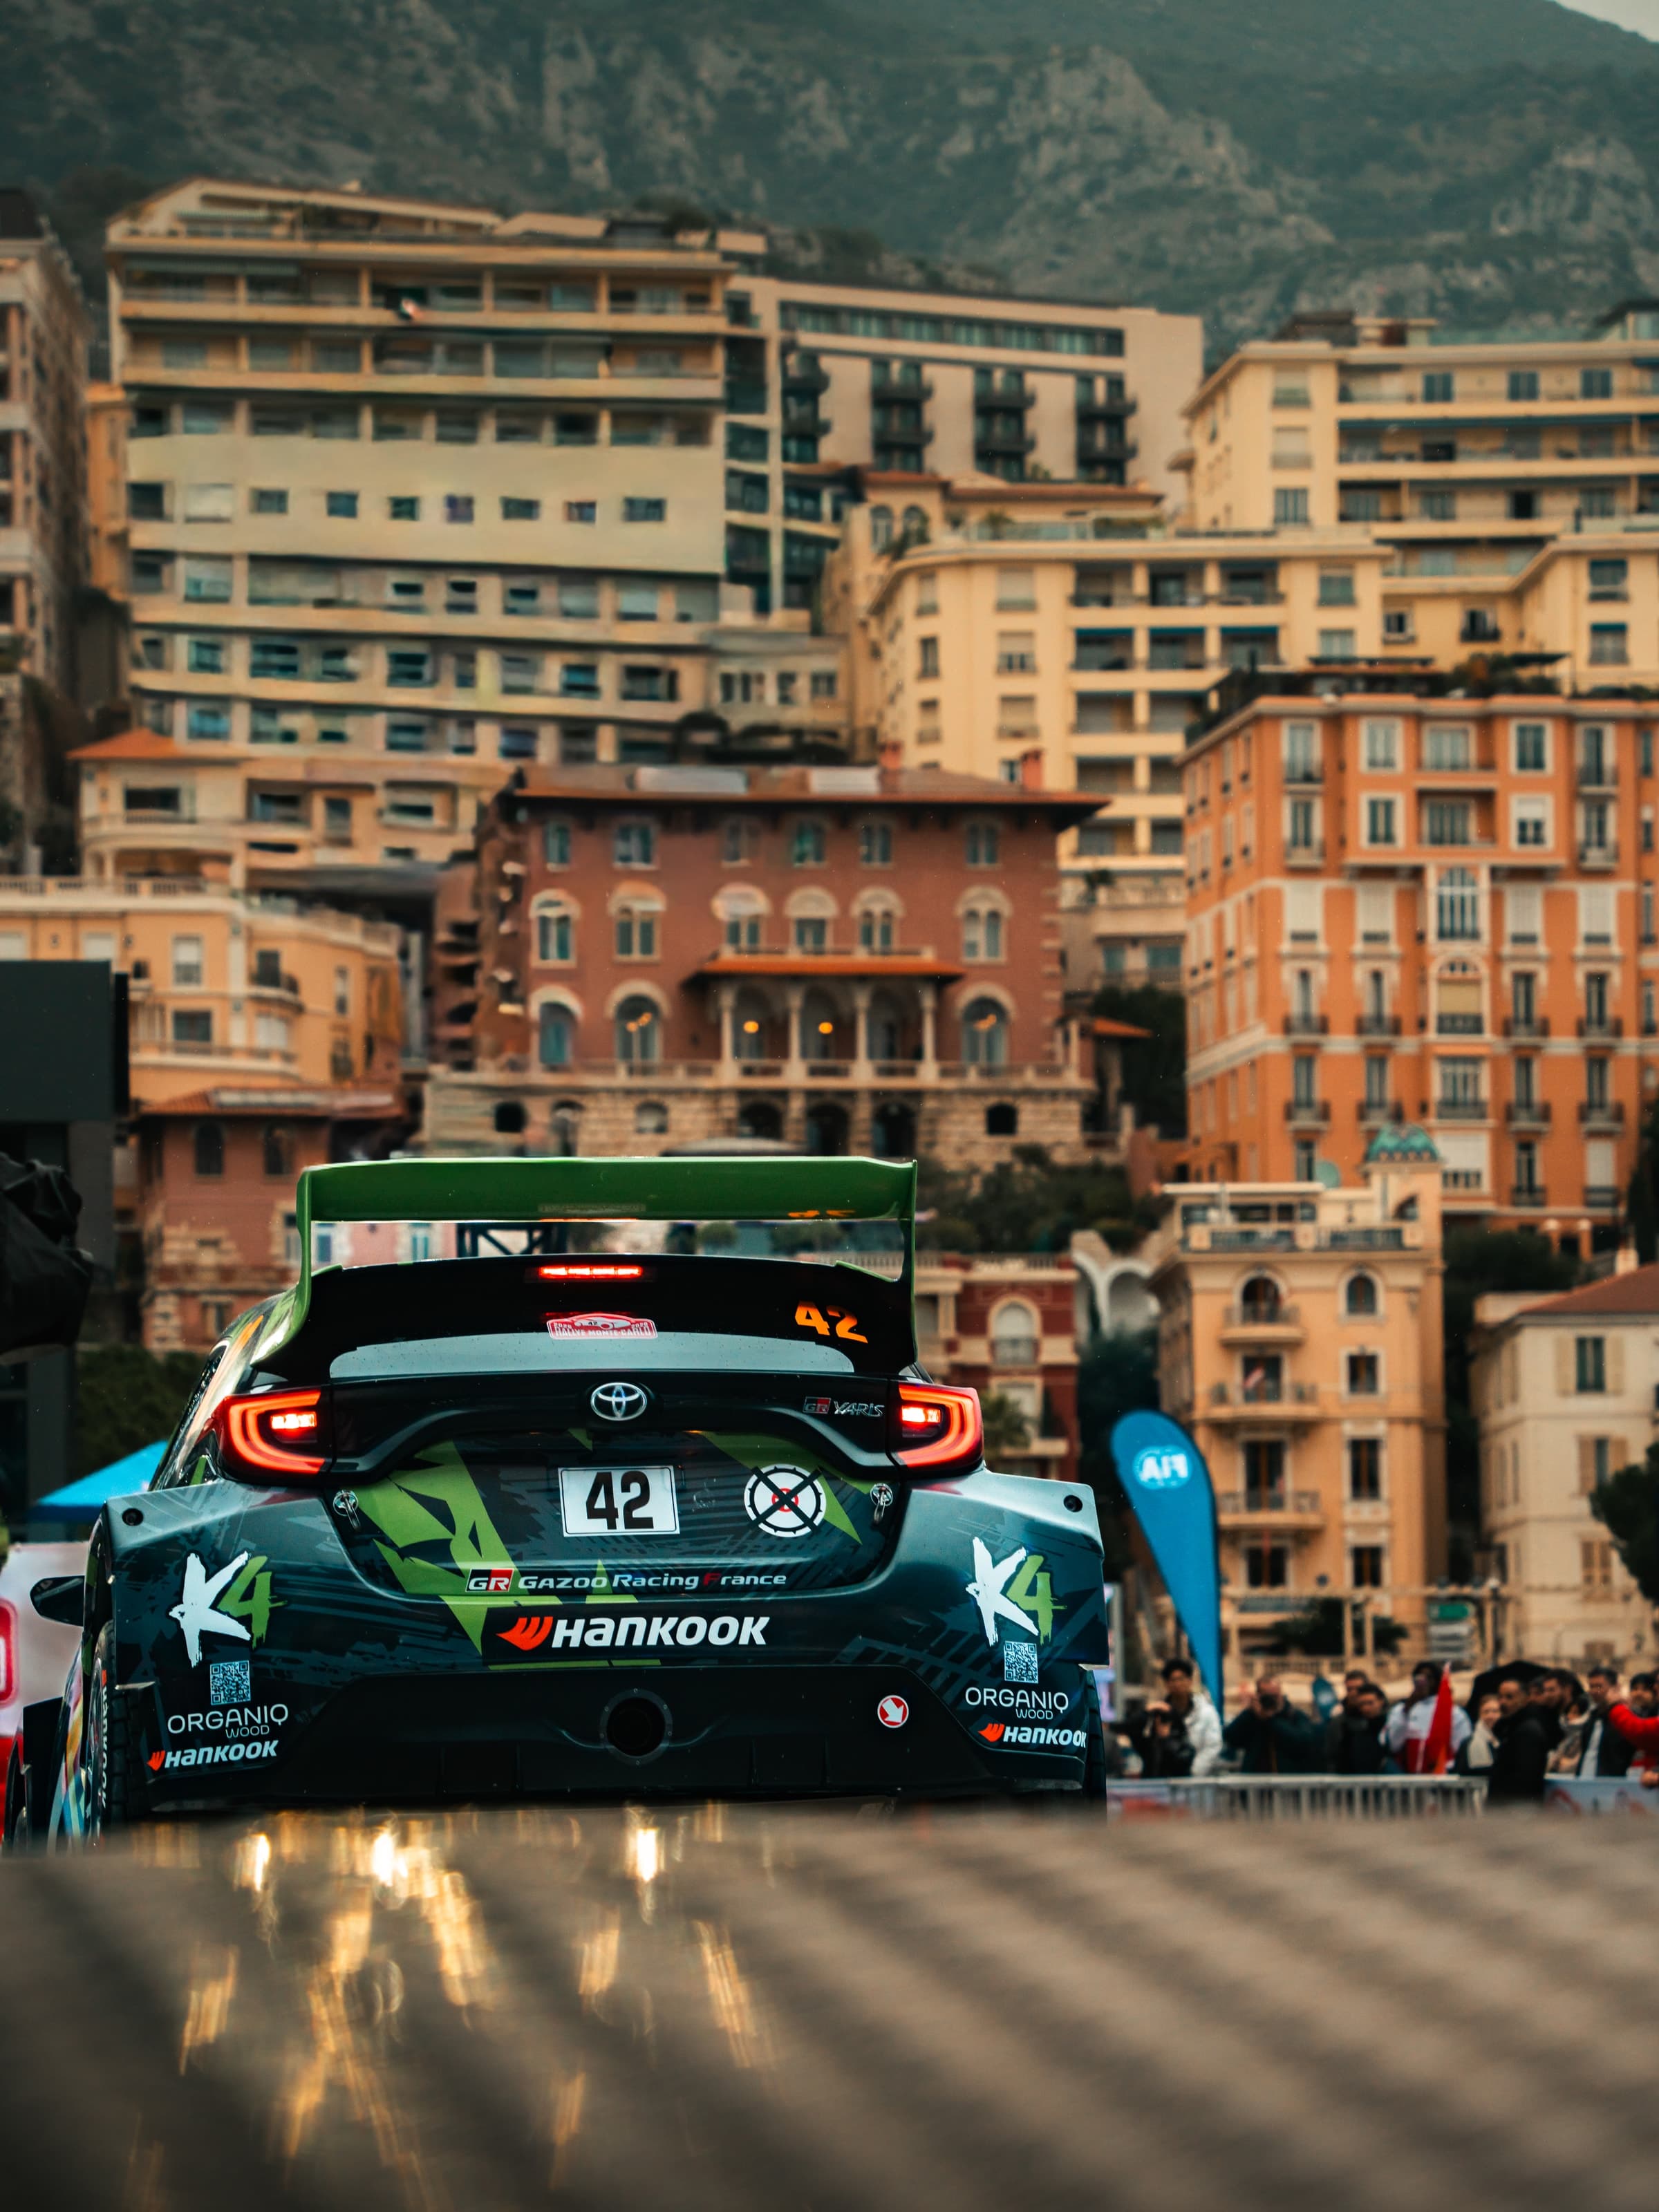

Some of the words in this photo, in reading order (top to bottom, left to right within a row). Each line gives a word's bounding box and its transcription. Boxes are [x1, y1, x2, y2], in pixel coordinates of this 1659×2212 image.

[555, 1326, 585, 1337] RALLYE
[795, 1301, 869, 1344] 42
[834, 1400, 885, 1417] YARIS
[585, 1470, 654, 1530] 42
[468, 1577, 509, 1591] GR
[612, 1573, 699, 1589] Racing
[703, 1573, 787, 1586] France
[966, 1537, 1068, 1647] K4
[168, 1550, 288, 1669] K4
[965, 1687, 1069, 1714] ORGANIQ
[1015, 1708, 1053, 1720] WOOD
[167, 1703, 289, 1734] ORGANIQ
[225, 1725, 270, 1738] WOOD
